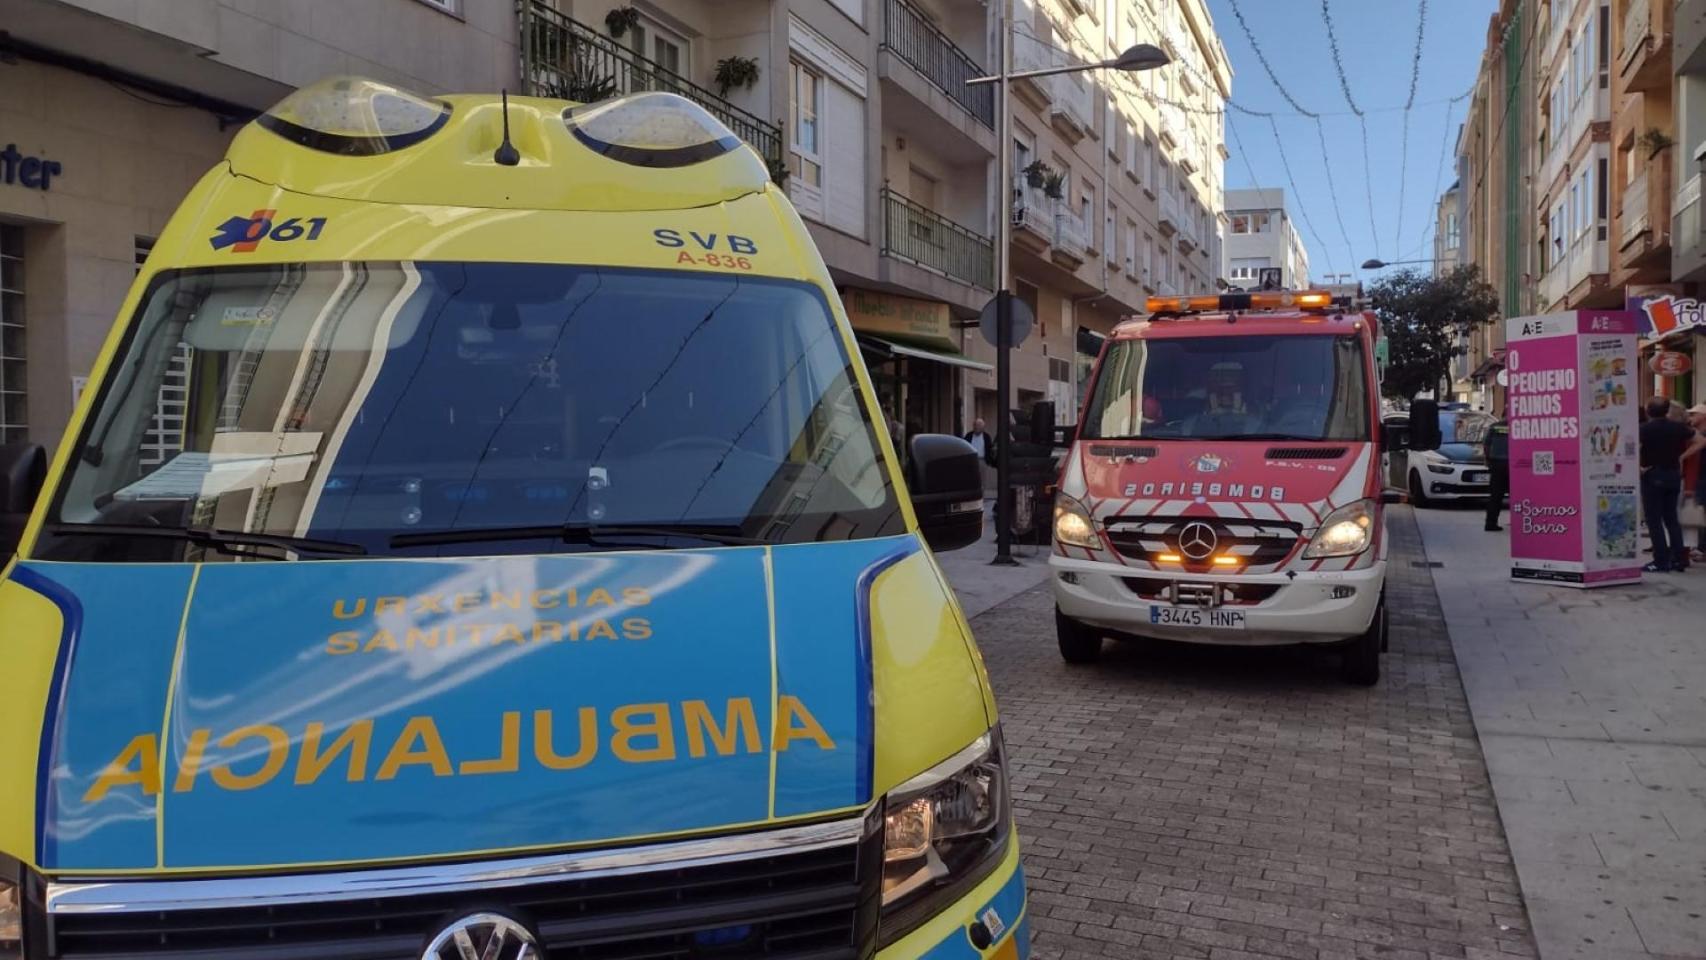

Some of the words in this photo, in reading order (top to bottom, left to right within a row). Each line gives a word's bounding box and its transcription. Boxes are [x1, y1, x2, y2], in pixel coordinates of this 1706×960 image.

[0, 144, 61, 190] ter
[246, 218, 327, 242] 061
[653, 229, 758, 254] SVB
[677, 251, 752, 270] A-836
[1509, 350, 1519, 371] O
[1510, 368, 1575, 394] PEQUENO
[1511, 393, 1561, 417] FAINOS
[1511, 416, 1578, 440] GRANDES
[1522, 516, 1568, 534] Boiro
[332, 587, 651, 619] URXENCIAS
[1162, 609, 1201, 625] 3445
[1210, 611, 1240, 626] HNP
[327, 617, 653, 655] SANITARIAS
